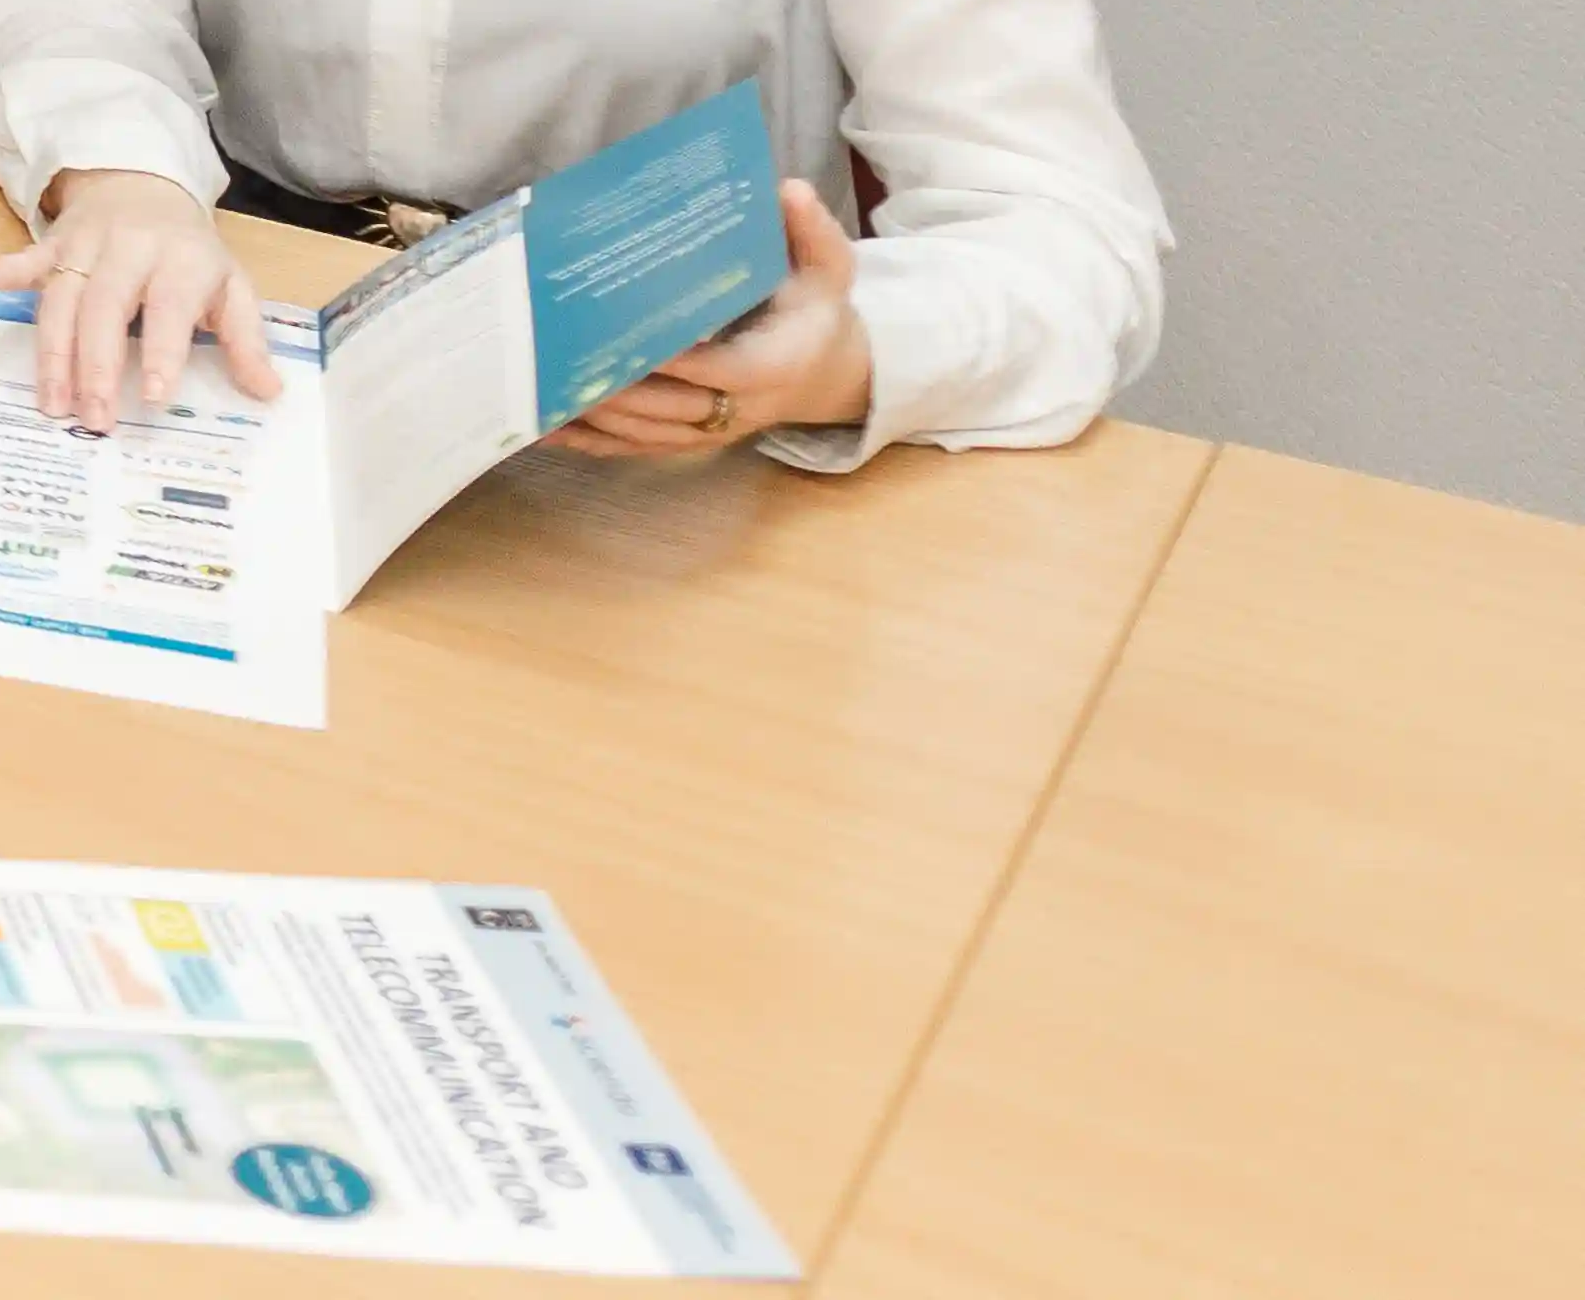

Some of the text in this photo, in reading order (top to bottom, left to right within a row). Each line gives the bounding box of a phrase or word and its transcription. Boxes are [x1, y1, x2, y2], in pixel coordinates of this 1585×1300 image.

[338, 913, 549, 1228] TELECOMMUNICATION
[416, 952, 588, 1191] TRANSPORT AND
